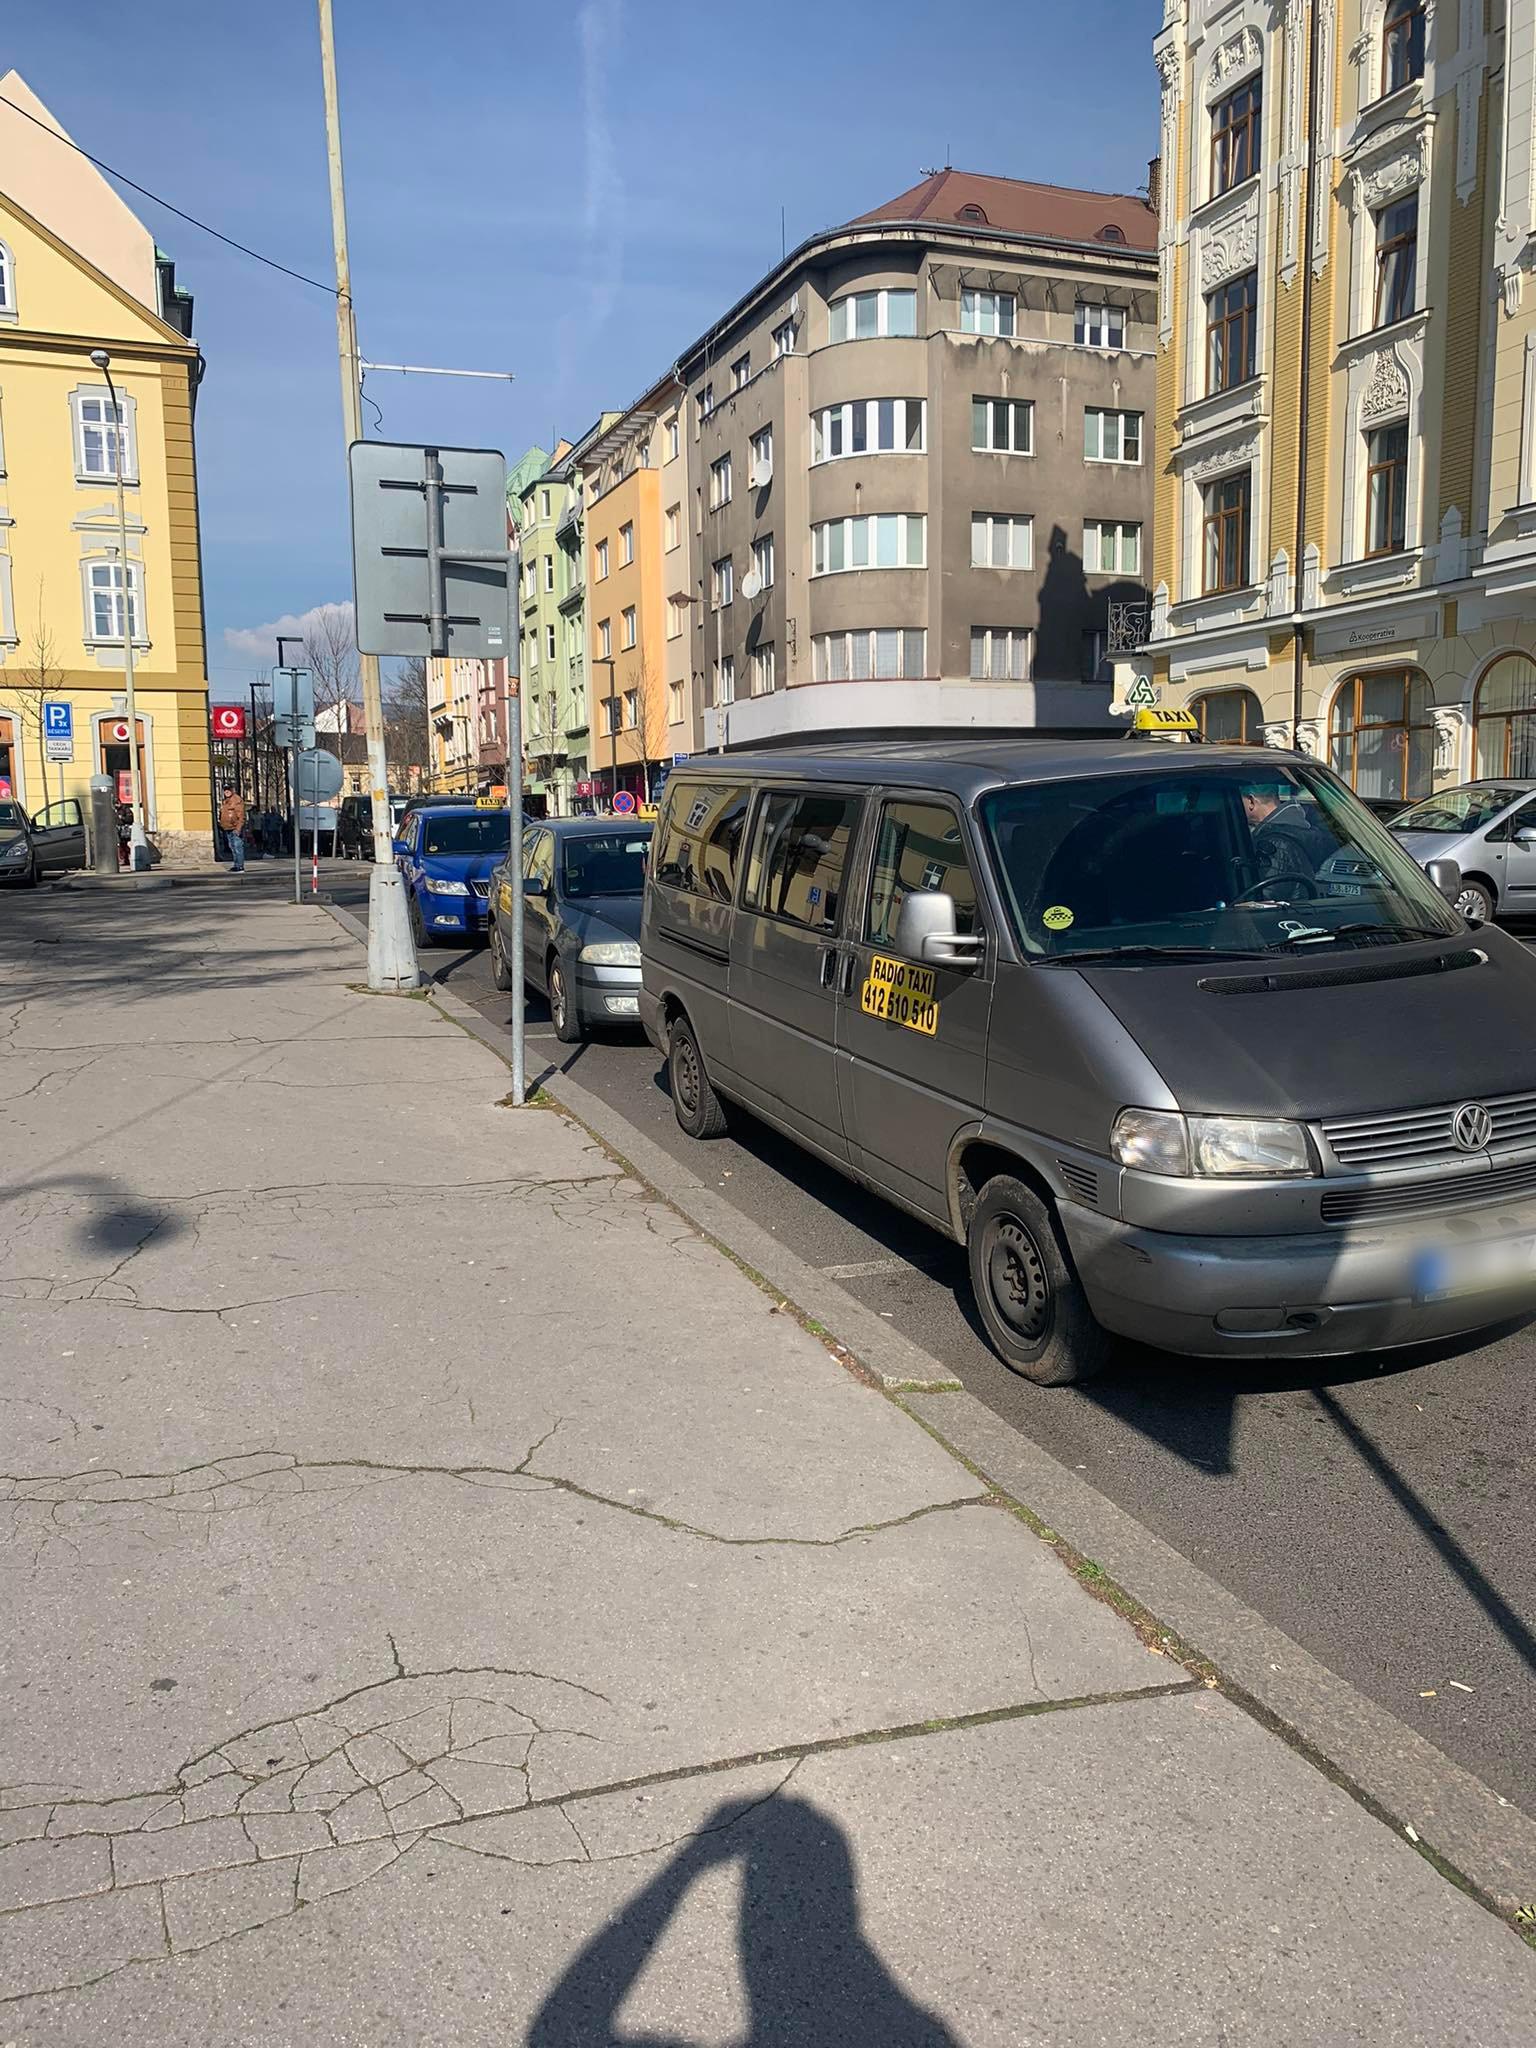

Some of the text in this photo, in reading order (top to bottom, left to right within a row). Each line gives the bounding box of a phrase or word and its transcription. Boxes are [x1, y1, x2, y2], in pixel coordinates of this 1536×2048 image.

[1358, 629, 1395, 641] Kooperativa
[50, 706, 66, 727] P
[1151, 710, 1191, 722] TAXI
[641, 804, 659, 812] TA
[873, 959, 933, 995] RADIO TAXI
[864, 984, 934, 1030] 412 510 510
